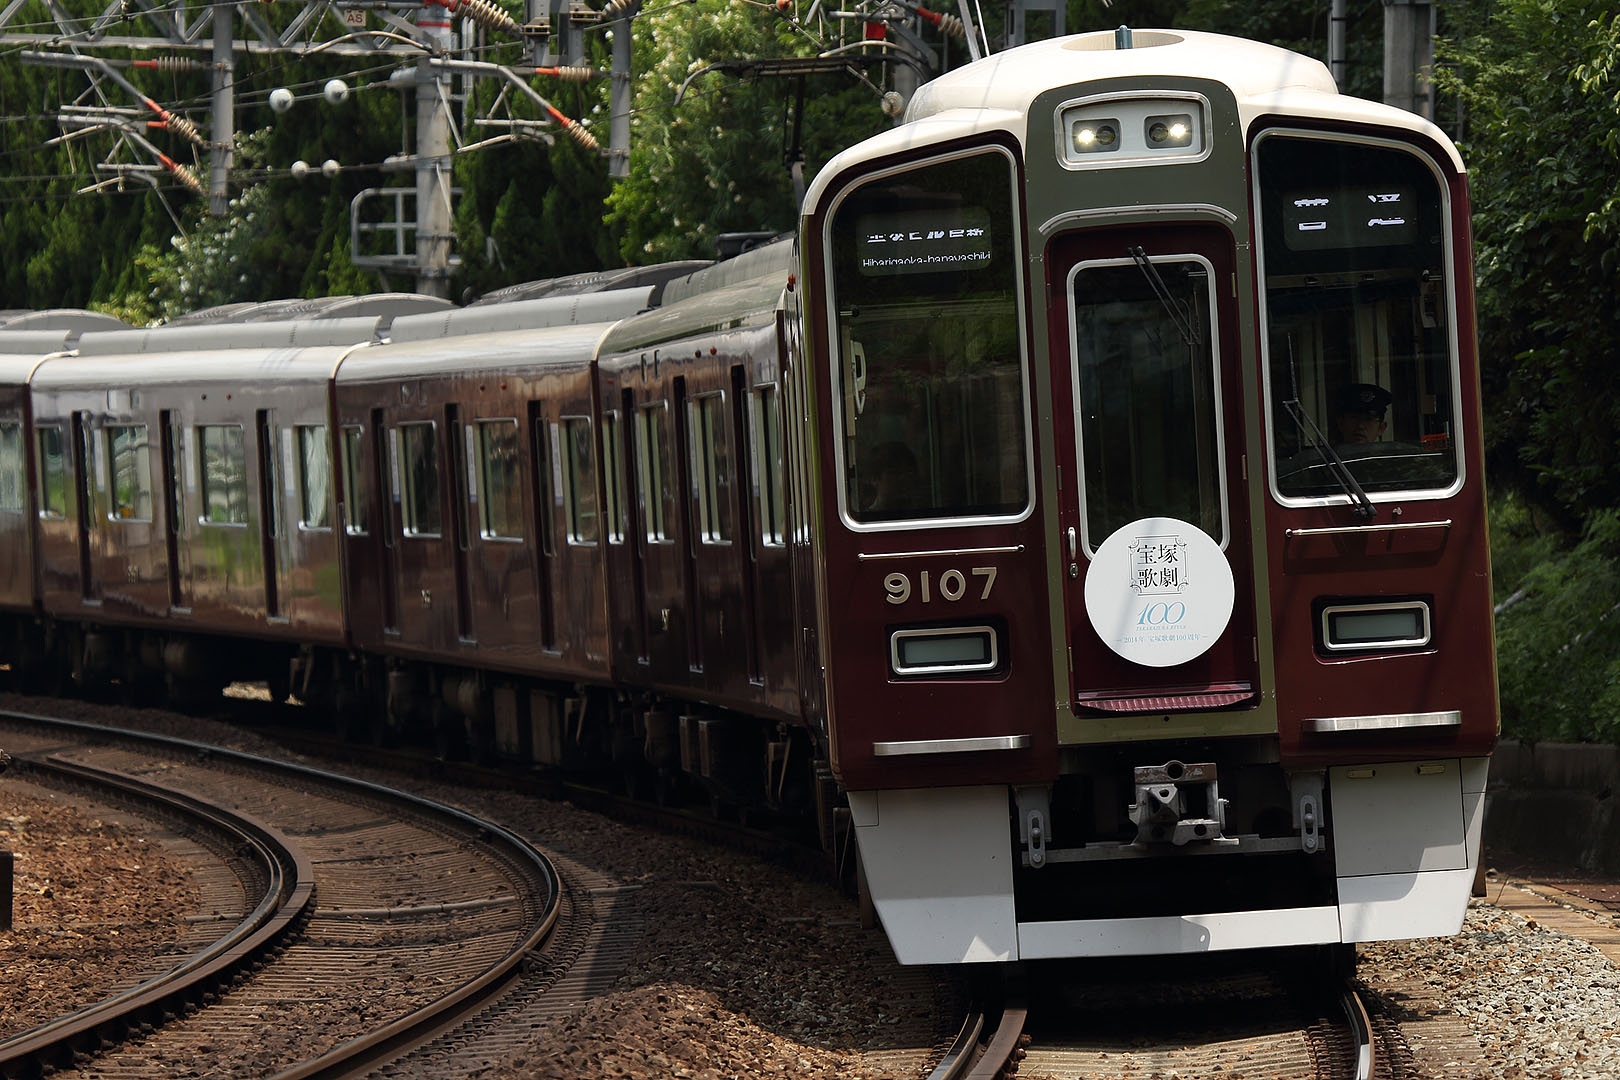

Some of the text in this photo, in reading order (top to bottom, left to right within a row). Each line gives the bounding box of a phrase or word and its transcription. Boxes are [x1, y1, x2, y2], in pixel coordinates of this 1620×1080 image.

[347, 13, 363, 23] AS
[1137, 544, 1179, 565] 宝塚
[883, 567, 998, 605] 9107
[1137, 567, 1179, 588] 歌劇
[1137, 601, 1186, 625] 100
